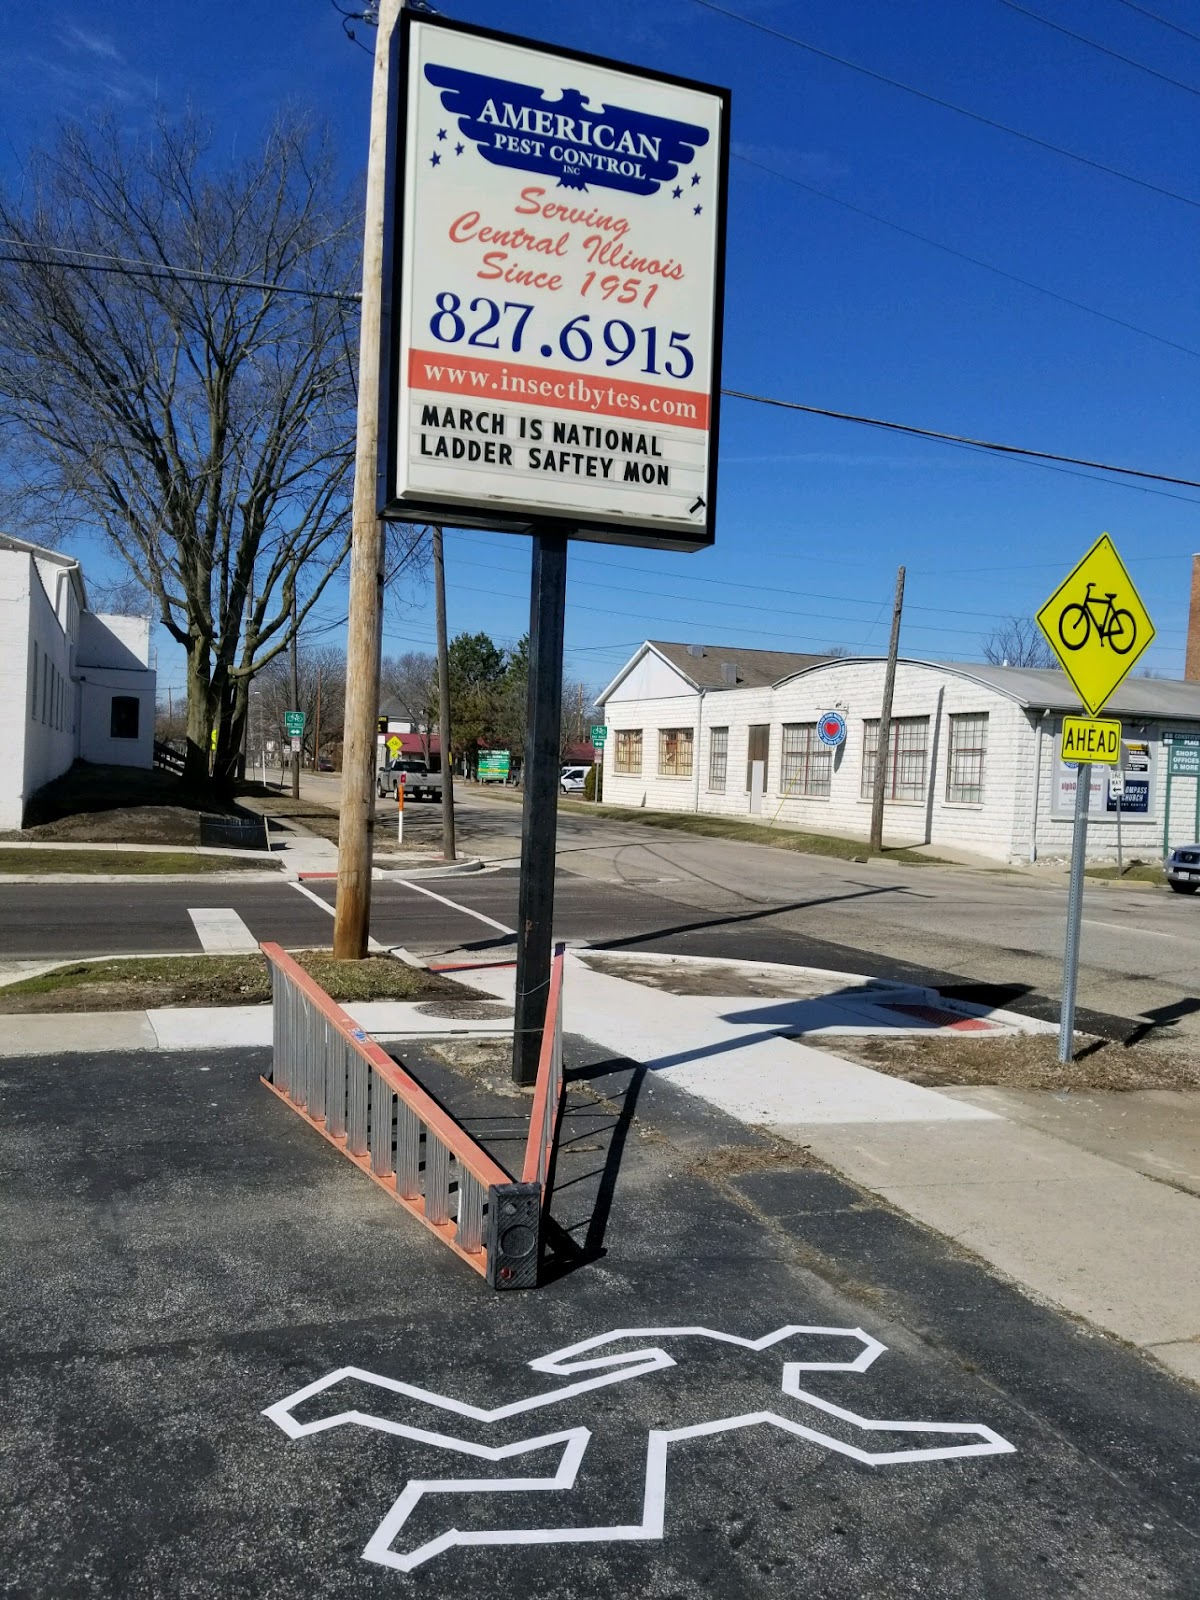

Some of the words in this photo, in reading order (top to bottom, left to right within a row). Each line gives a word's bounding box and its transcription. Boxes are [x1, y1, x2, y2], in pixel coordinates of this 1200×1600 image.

[476, 98, 662, 163] AMERICAN
[493, 133, 545, 159] PEST
[549, 145, 647, 180] CONTROL
[562, 165, 581, 176] INC
[514, 186, 631, 241] Serving
[448, 211, 569, 257] Central
[582, 234, 686, 281] Illinois
[476, 251, 564, 292] Since
[580, 270, 659, 309] 1951
[429, 291, 694, 379] 827.6915
[423, 363, 698, 419] www.insectbytes.com
[420, 404, 505, 436] MARCH
[519, 416, 544, 441] IS
[552, 422, 663, 457] NATIONAL
[420, 433, 513, 466] LADDER
[528, 447, 614, 480] SAFTEY
[623, 460, 670, 487] MON
[1065, 727, 1117, 753] AHEAD
[1172, 756, 1200, 764] OFFICES
[1175, 750, 1198, 758] SHOPS
[1121, 793, 1144, 802] CHURCH
[1125, 785, 1148, 795] OMPASS
